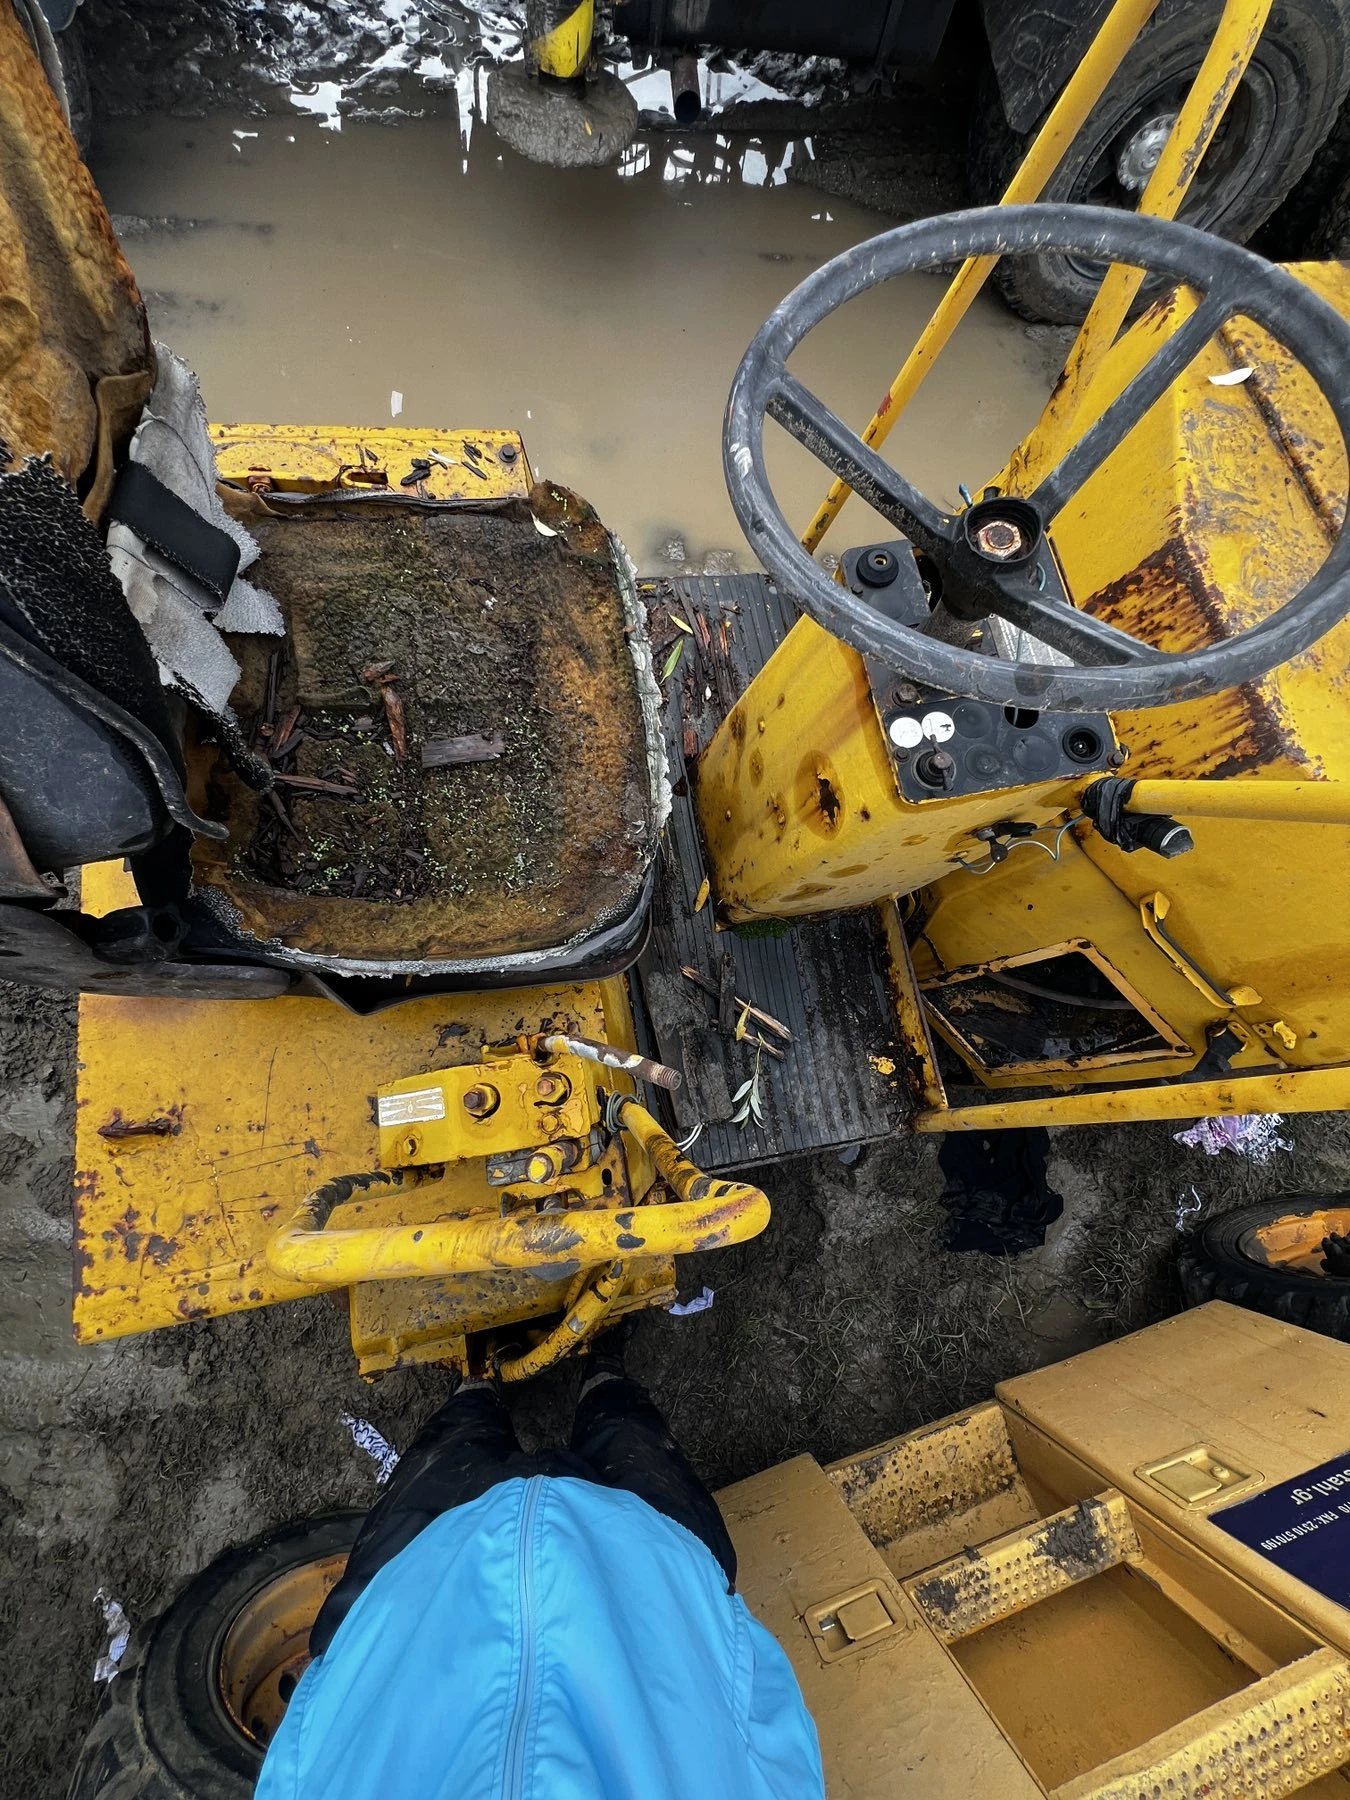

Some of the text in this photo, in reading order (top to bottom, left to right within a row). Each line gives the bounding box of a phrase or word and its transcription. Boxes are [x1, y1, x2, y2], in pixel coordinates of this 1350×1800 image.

[1313, 1510, 1339, 1525] FAX:
[1291, 1520, 1319, 1536] 2310
[1260, 1531, 1298, 1551] 570199
